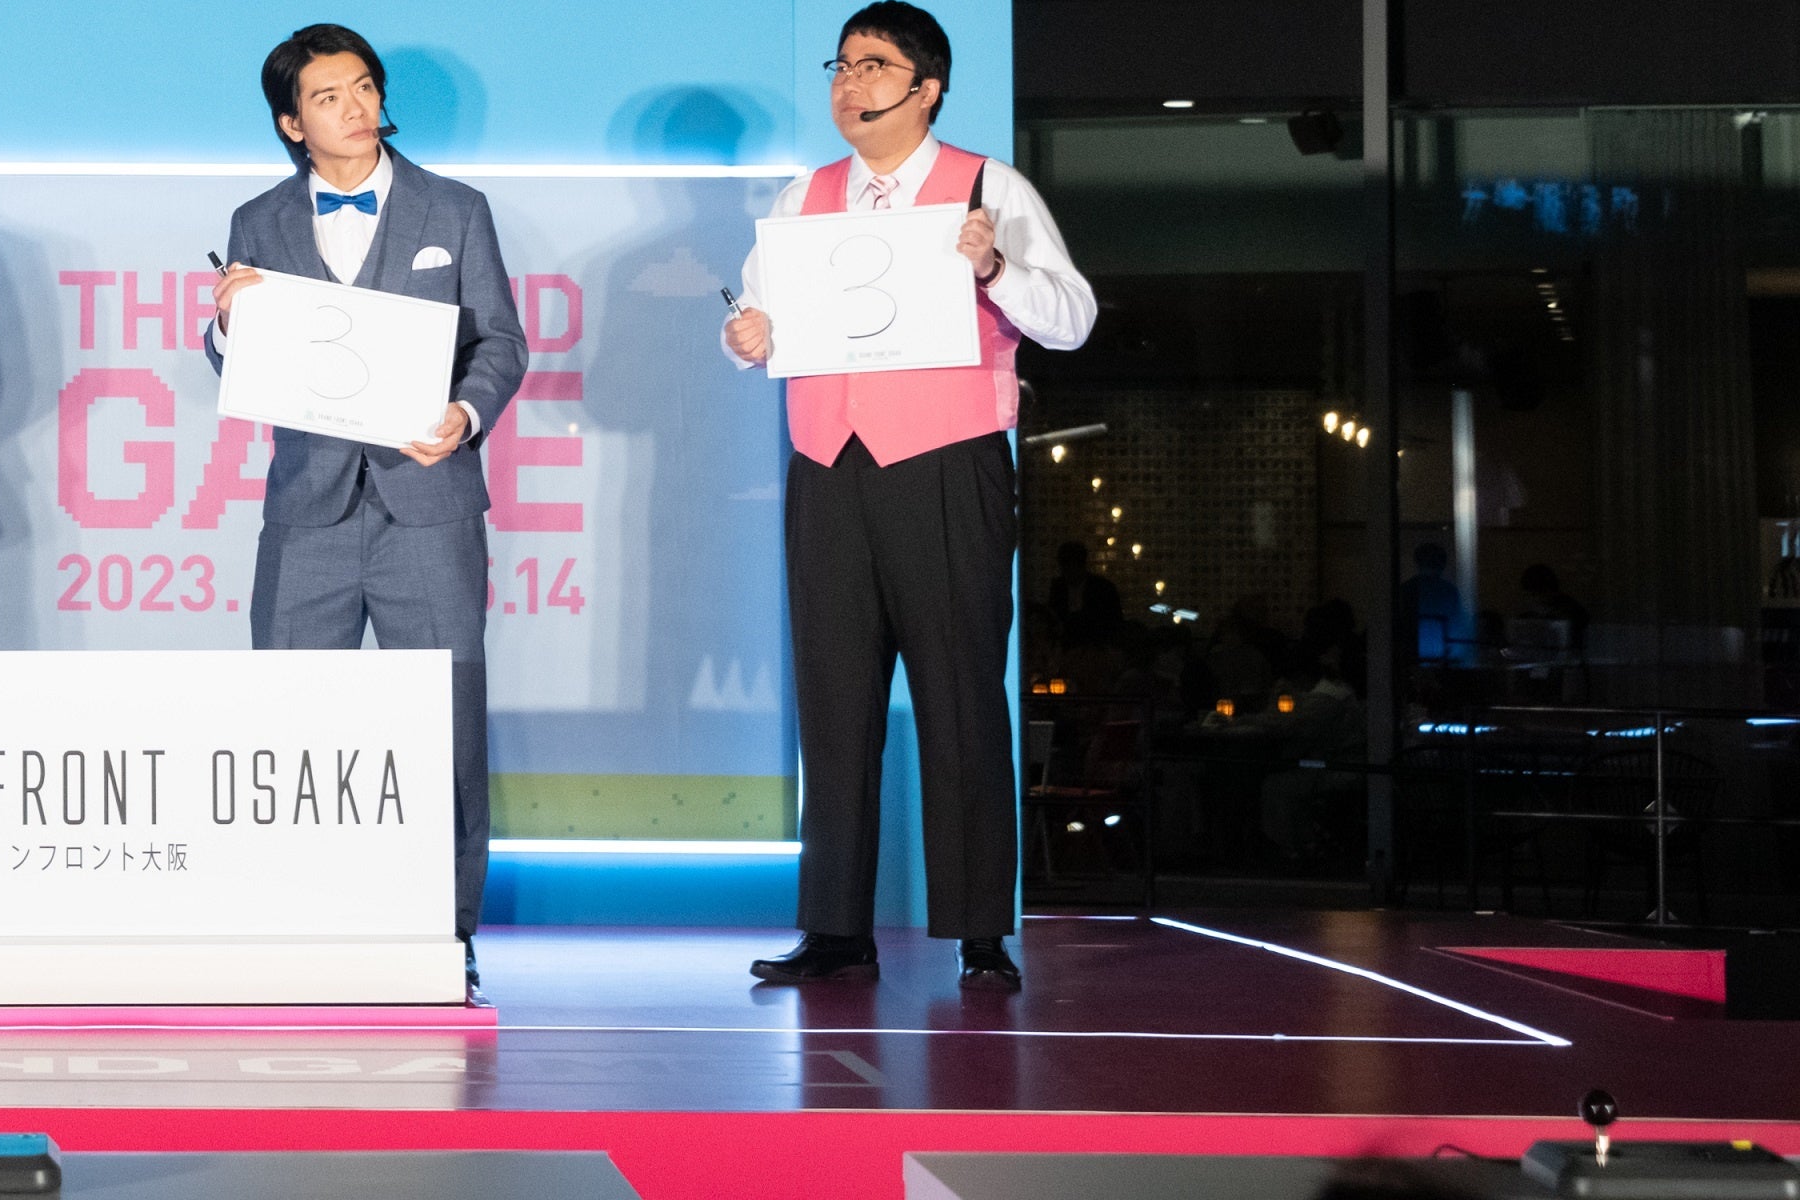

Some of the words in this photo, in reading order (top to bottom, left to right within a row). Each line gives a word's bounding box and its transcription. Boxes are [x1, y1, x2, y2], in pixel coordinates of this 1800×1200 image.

[58, 271, 219, 350] THE
[828, 233, 899, 340] 3
[306, 304, 371, 401] 3
[57, 367, 584, 533] GAE
[487, 556, 587, 616] .14
[211, 748, 406, 826] OSAKA
